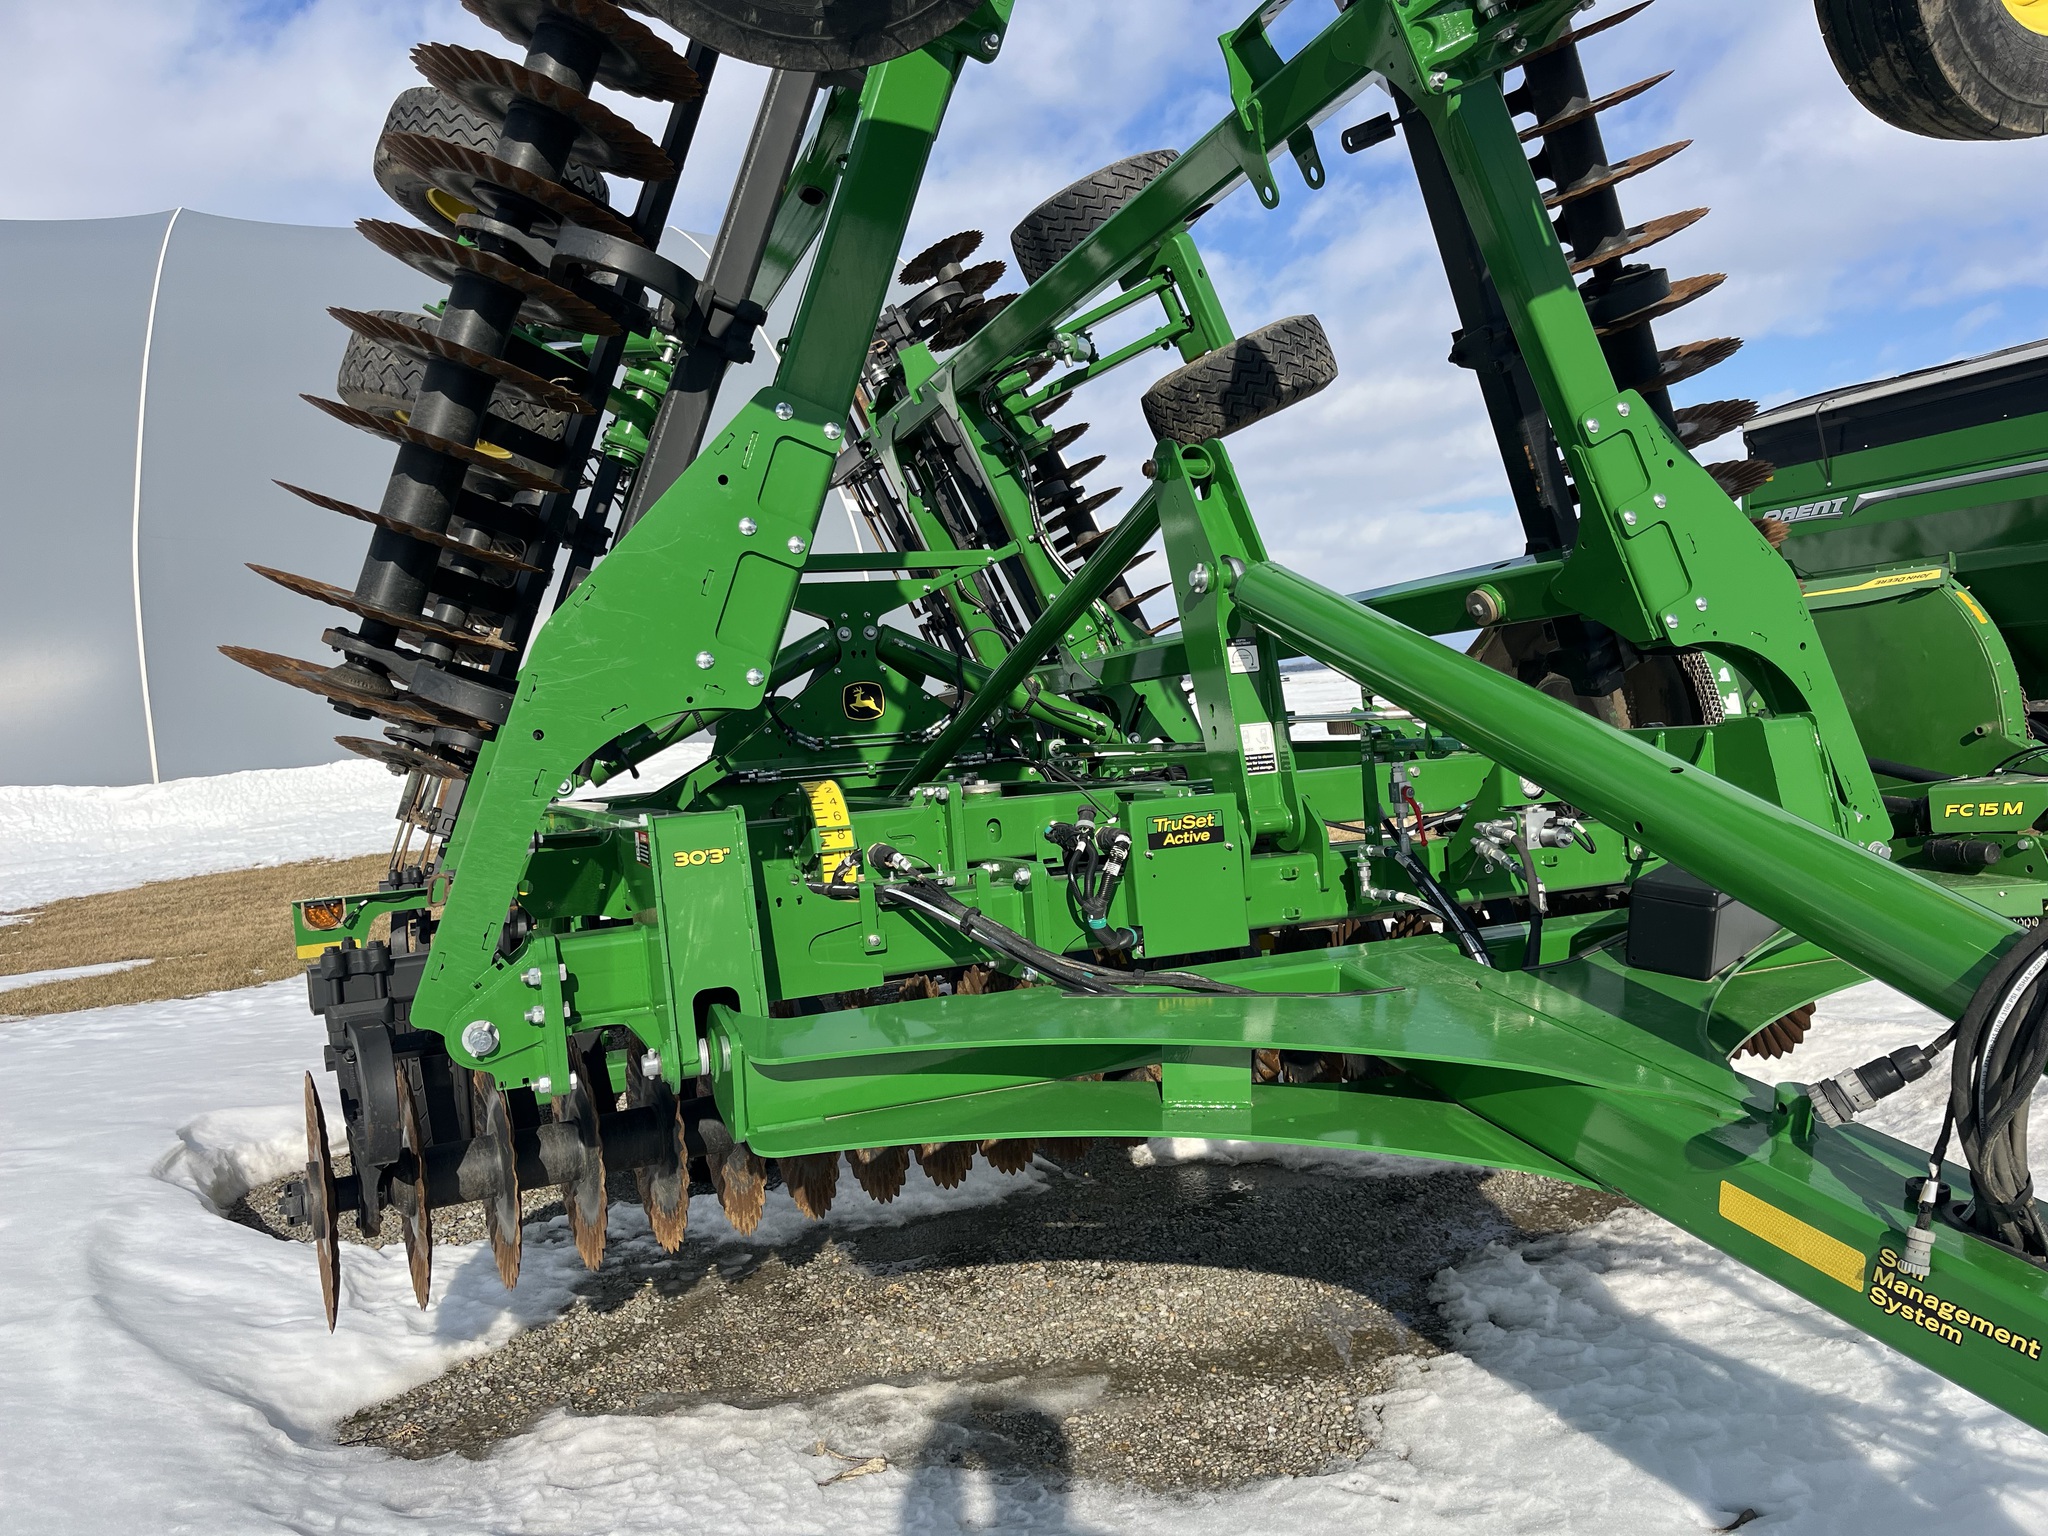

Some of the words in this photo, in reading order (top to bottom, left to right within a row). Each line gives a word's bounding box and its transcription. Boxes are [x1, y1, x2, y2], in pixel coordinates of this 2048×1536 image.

[1874, 577, 1906, 586] DEERE
[1906, 573, 1933, 581] JOHN
[833, 811, 841, 821] 6
[1945, 804, 1975, 818] FC
[1979, 802, 1999, 817] 15
[2003, 801, 2025, 816] M
[1153, 813, 1215, 833] TruSet
[837, 829, 845, 840] 8
[1163, 830, 1210, 846] Active
[673, 847, 730, 868] 30'3"
[1868, 1286, 1963, 1345] System
[1872, 1266, 2041, 1360] Management
